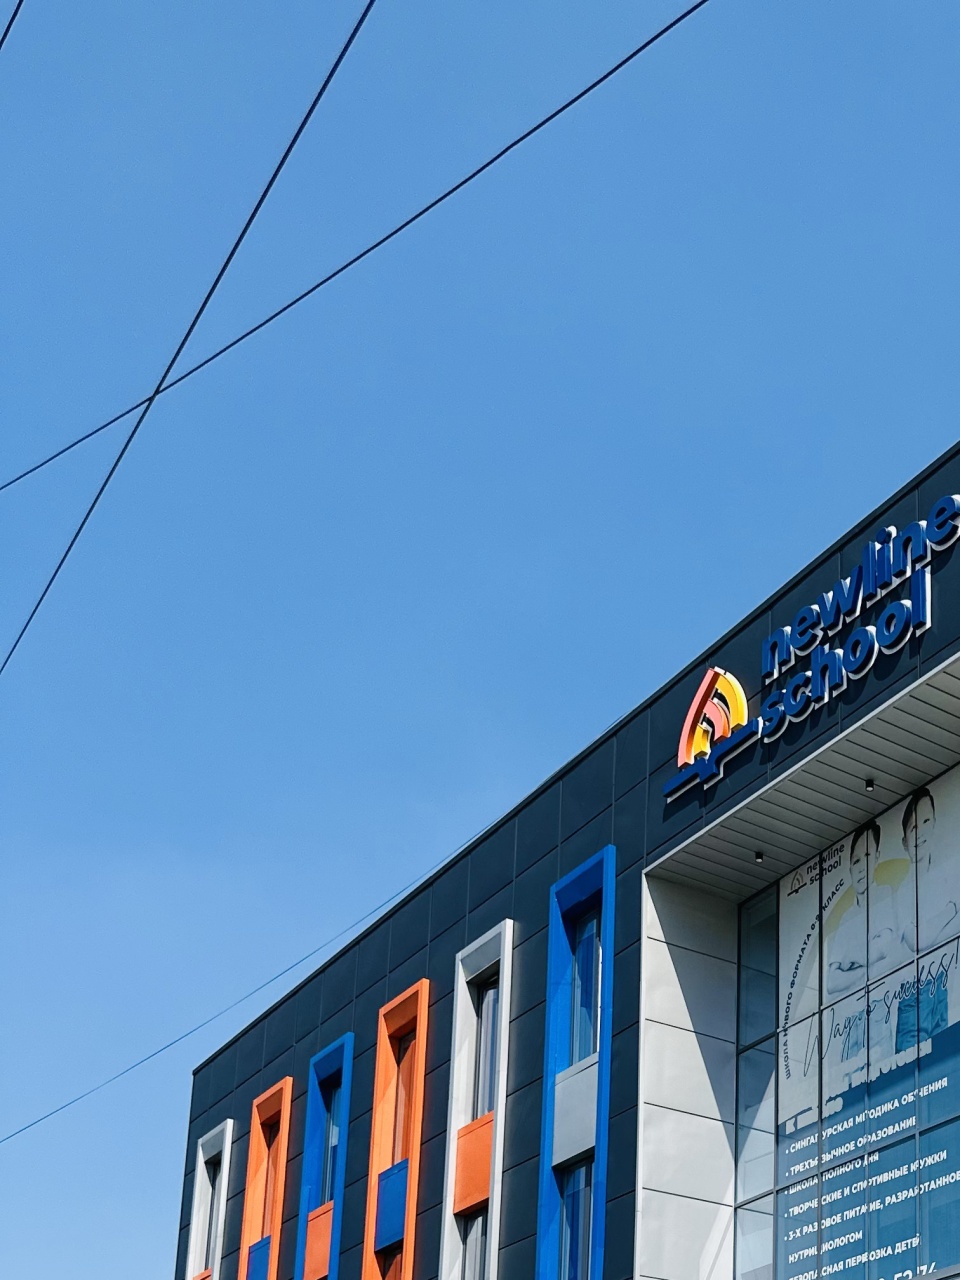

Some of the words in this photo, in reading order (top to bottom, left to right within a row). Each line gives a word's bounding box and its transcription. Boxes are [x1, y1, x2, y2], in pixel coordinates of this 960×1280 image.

[762, 565, 931, 743] school
[789, 1176, 818, 1194] ШКОЛА
[822, 1159, 862, 1181] ПОЛНОГО
[844, 1187, 849, 1197] И
